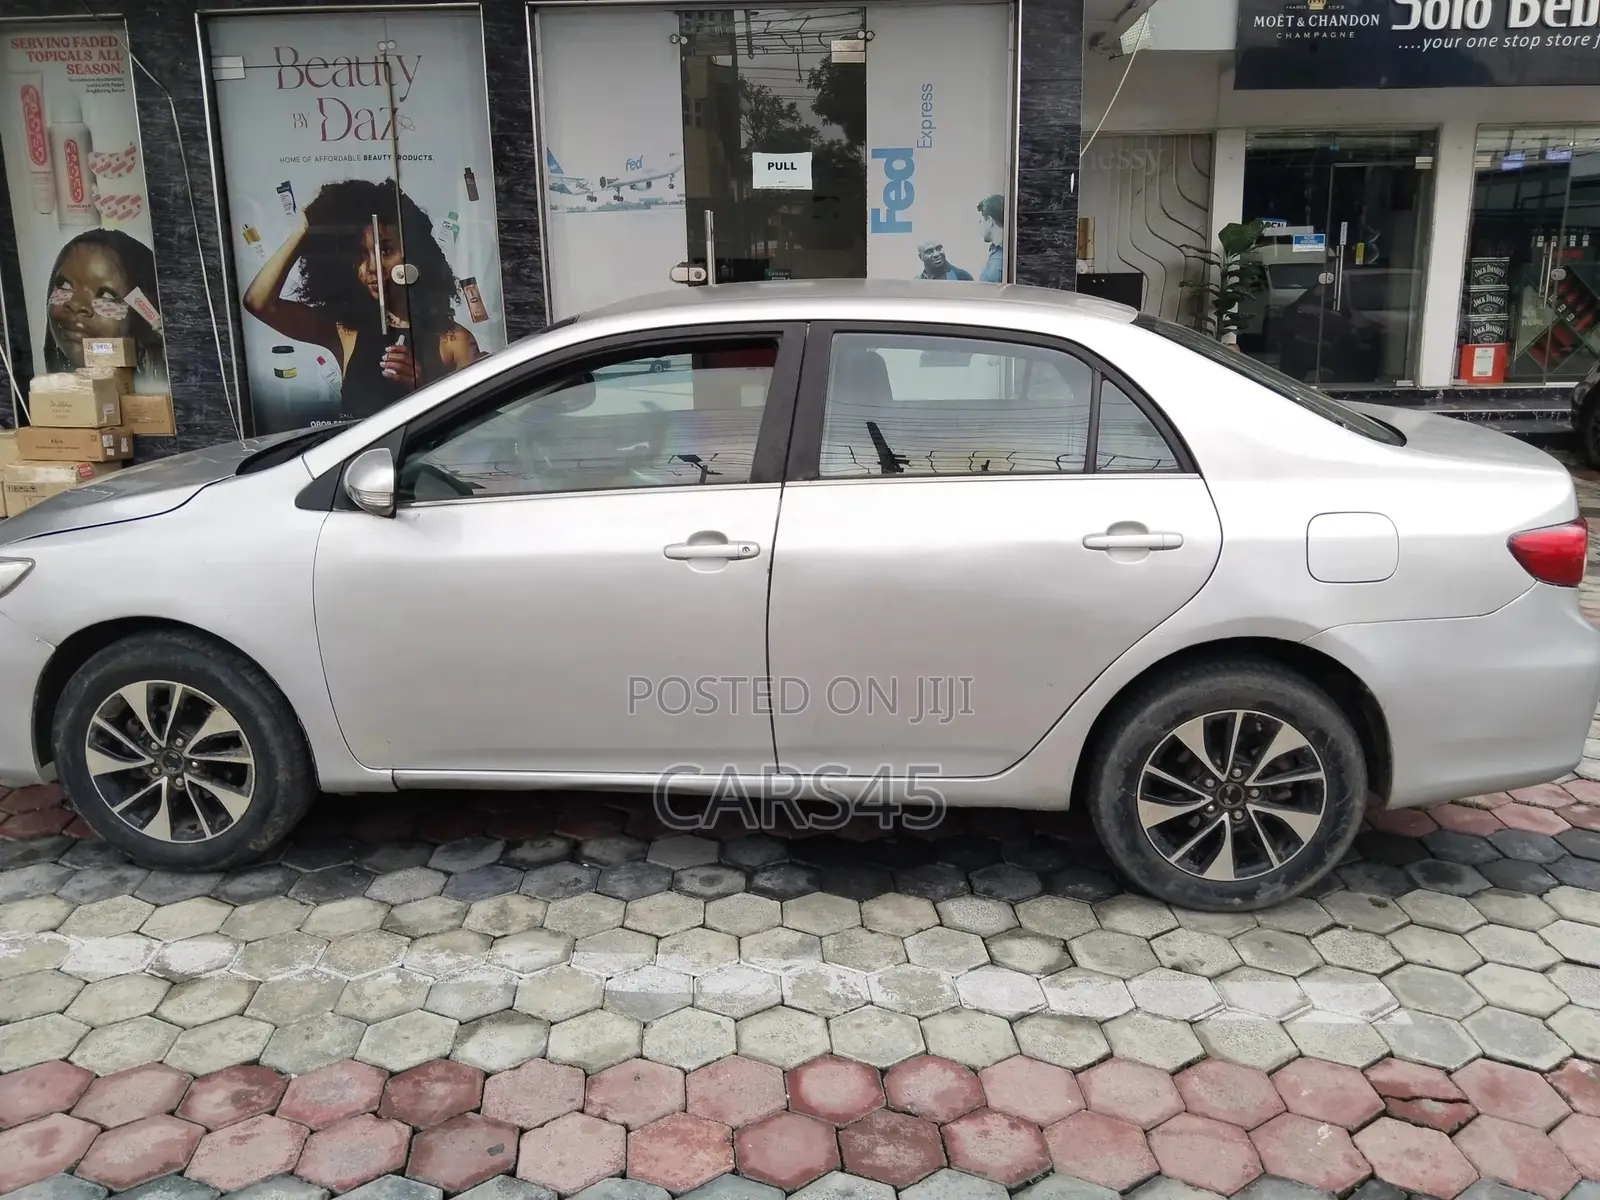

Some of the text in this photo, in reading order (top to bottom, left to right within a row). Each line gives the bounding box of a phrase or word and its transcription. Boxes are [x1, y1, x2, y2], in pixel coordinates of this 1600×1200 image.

[1253, 13, 1381, 27] MOËT & CHANDON
[1391, 0, 1493, 30] Solo
[1276, 31, 1356, 39] CHAMPAGNE
[1466, 36, 1499, 49] one
[1502, 34, 1541, 50] stop
[1545, 33, 1591, 47] store
[11, 35, 119, 50] SERVING FADED
[26, 49, 124, 62] TOPICALS ALL
[66, 62, 125, 75] SEASON.
[273, 46, 423, 103] Beauty
[292, 97, 399, 142] BY Daz
[916, 83, 937, 149] Express
[280, 156, 301, 164] HOME
[314, 155, 362, 163] AFFORDABLE
[363, 154, 392, 162] BEAUTY
[626, 154, 644, 172] Fed
[767, 162, 798, 171] PULL
[870, 147, 915, 234] Fed
[1474, 266, 1487, 278] JACK
[1473, 296, 1486, 308] JACK
[1473, 326, 1486, 337] JACK
